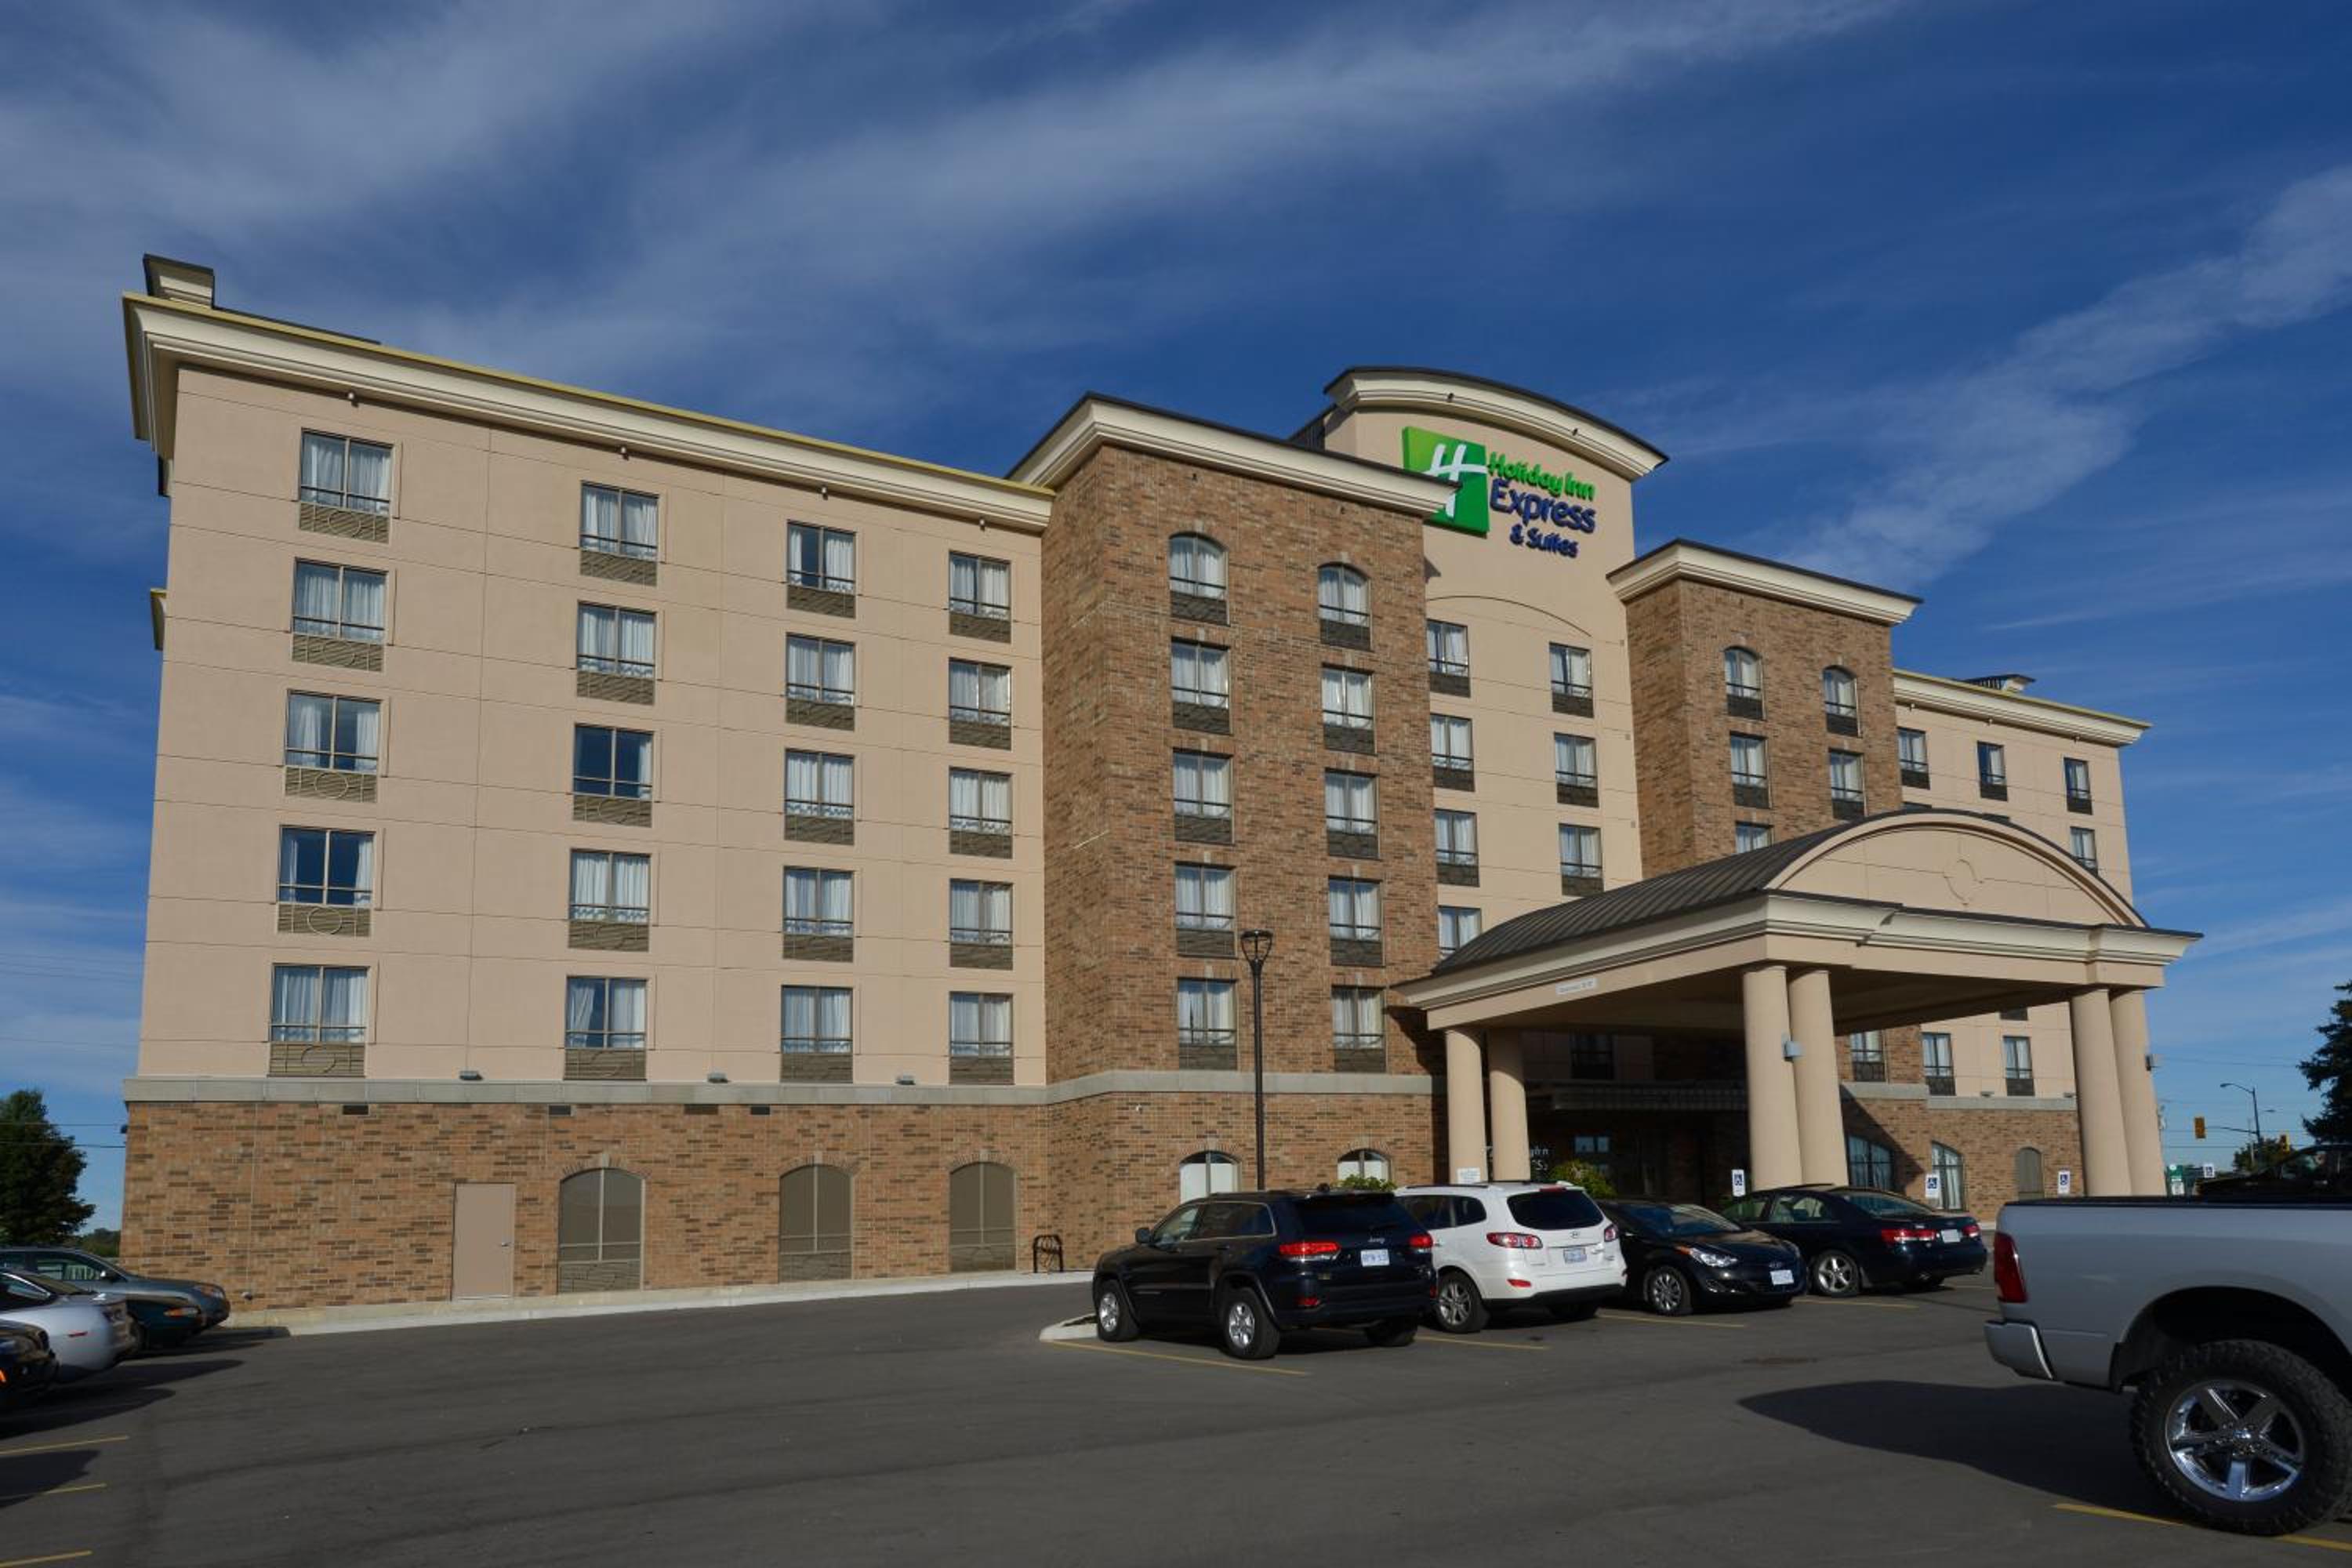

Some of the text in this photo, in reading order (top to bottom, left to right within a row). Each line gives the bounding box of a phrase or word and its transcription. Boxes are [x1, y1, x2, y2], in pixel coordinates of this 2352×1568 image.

[1488, 452, 1595, 501] Holiday Inn
[1490, 477, 1596, 534] Express
[1509, 524, 1579, 558] & Suites
